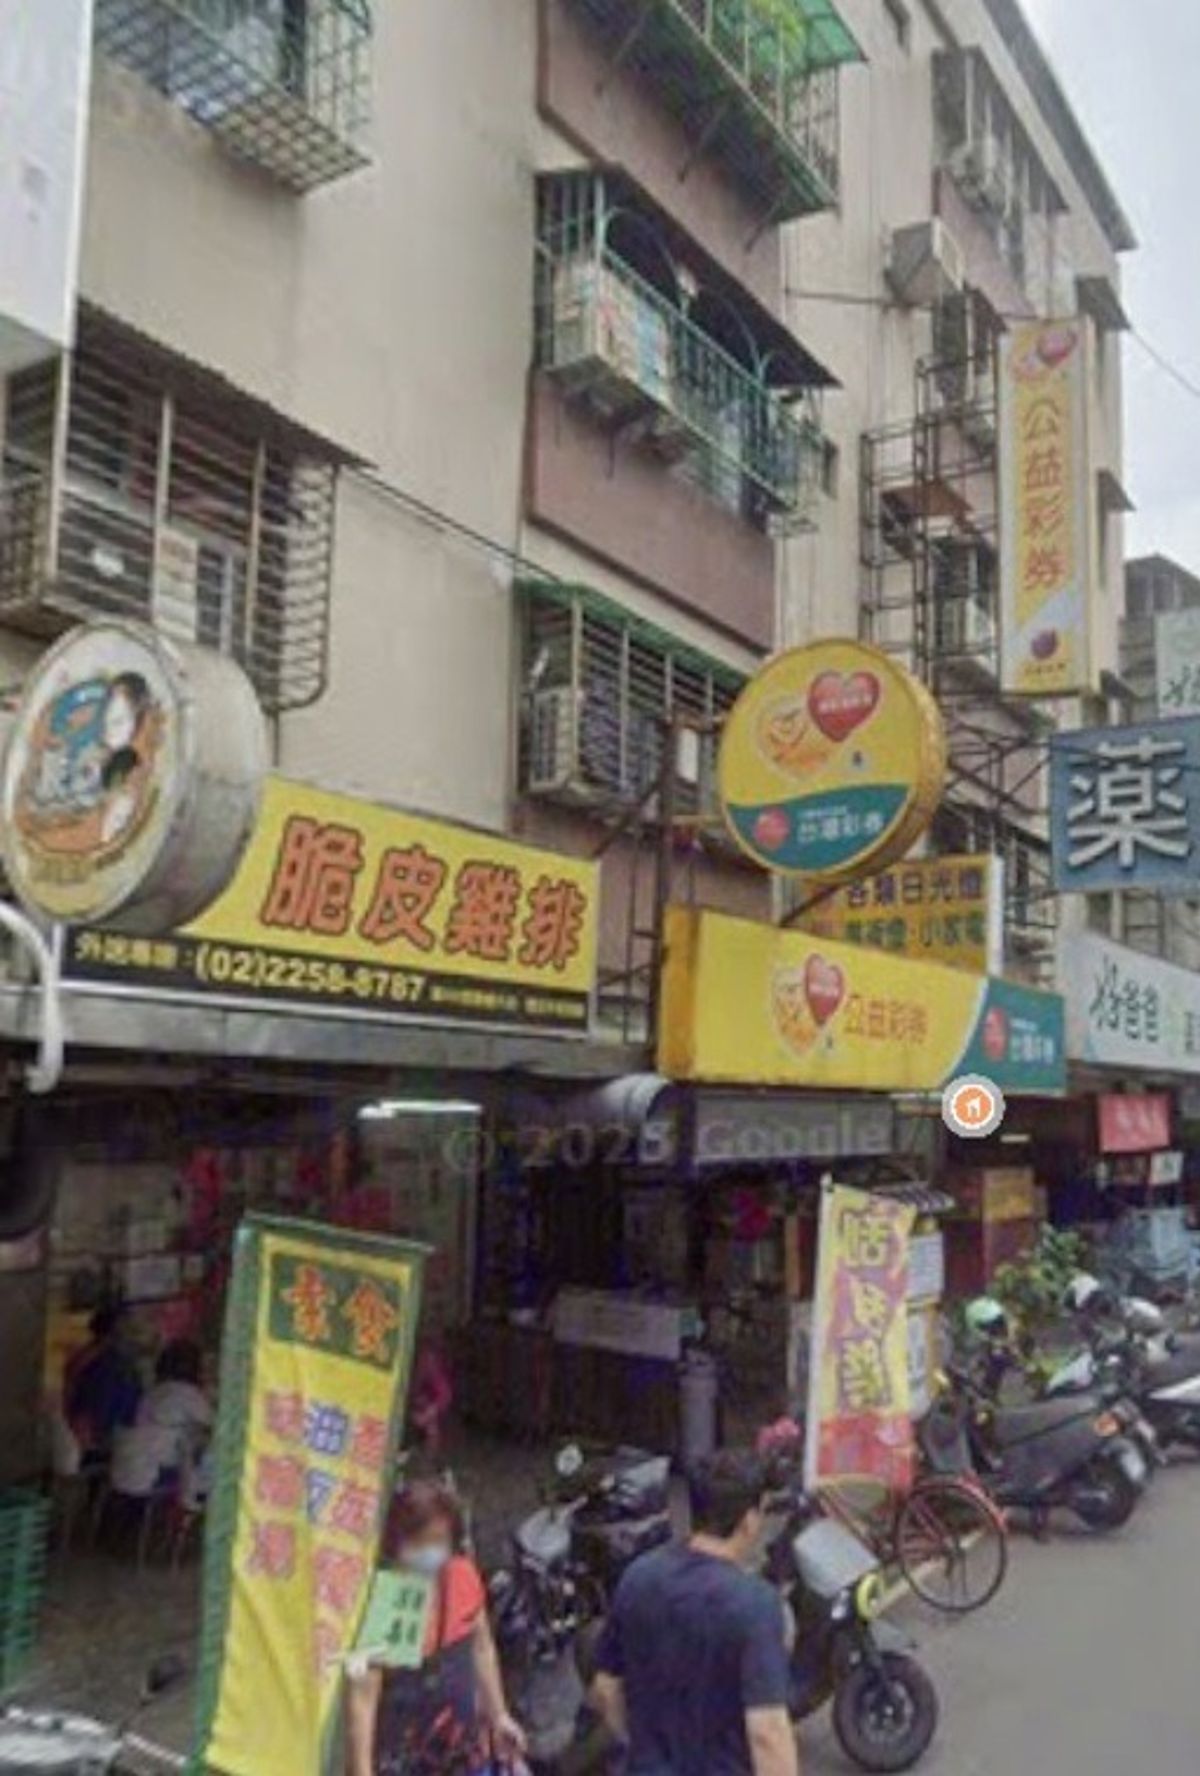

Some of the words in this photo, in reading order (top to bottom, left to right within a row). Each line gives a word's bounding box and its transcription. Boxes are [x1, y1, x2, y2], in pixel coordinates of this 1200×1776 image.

[1023, 398, 1064, 592] 公益彩券
[261, 814, 588, 972] 脆皮雞排
[843, 993, 930, 1045] 公益彩券
